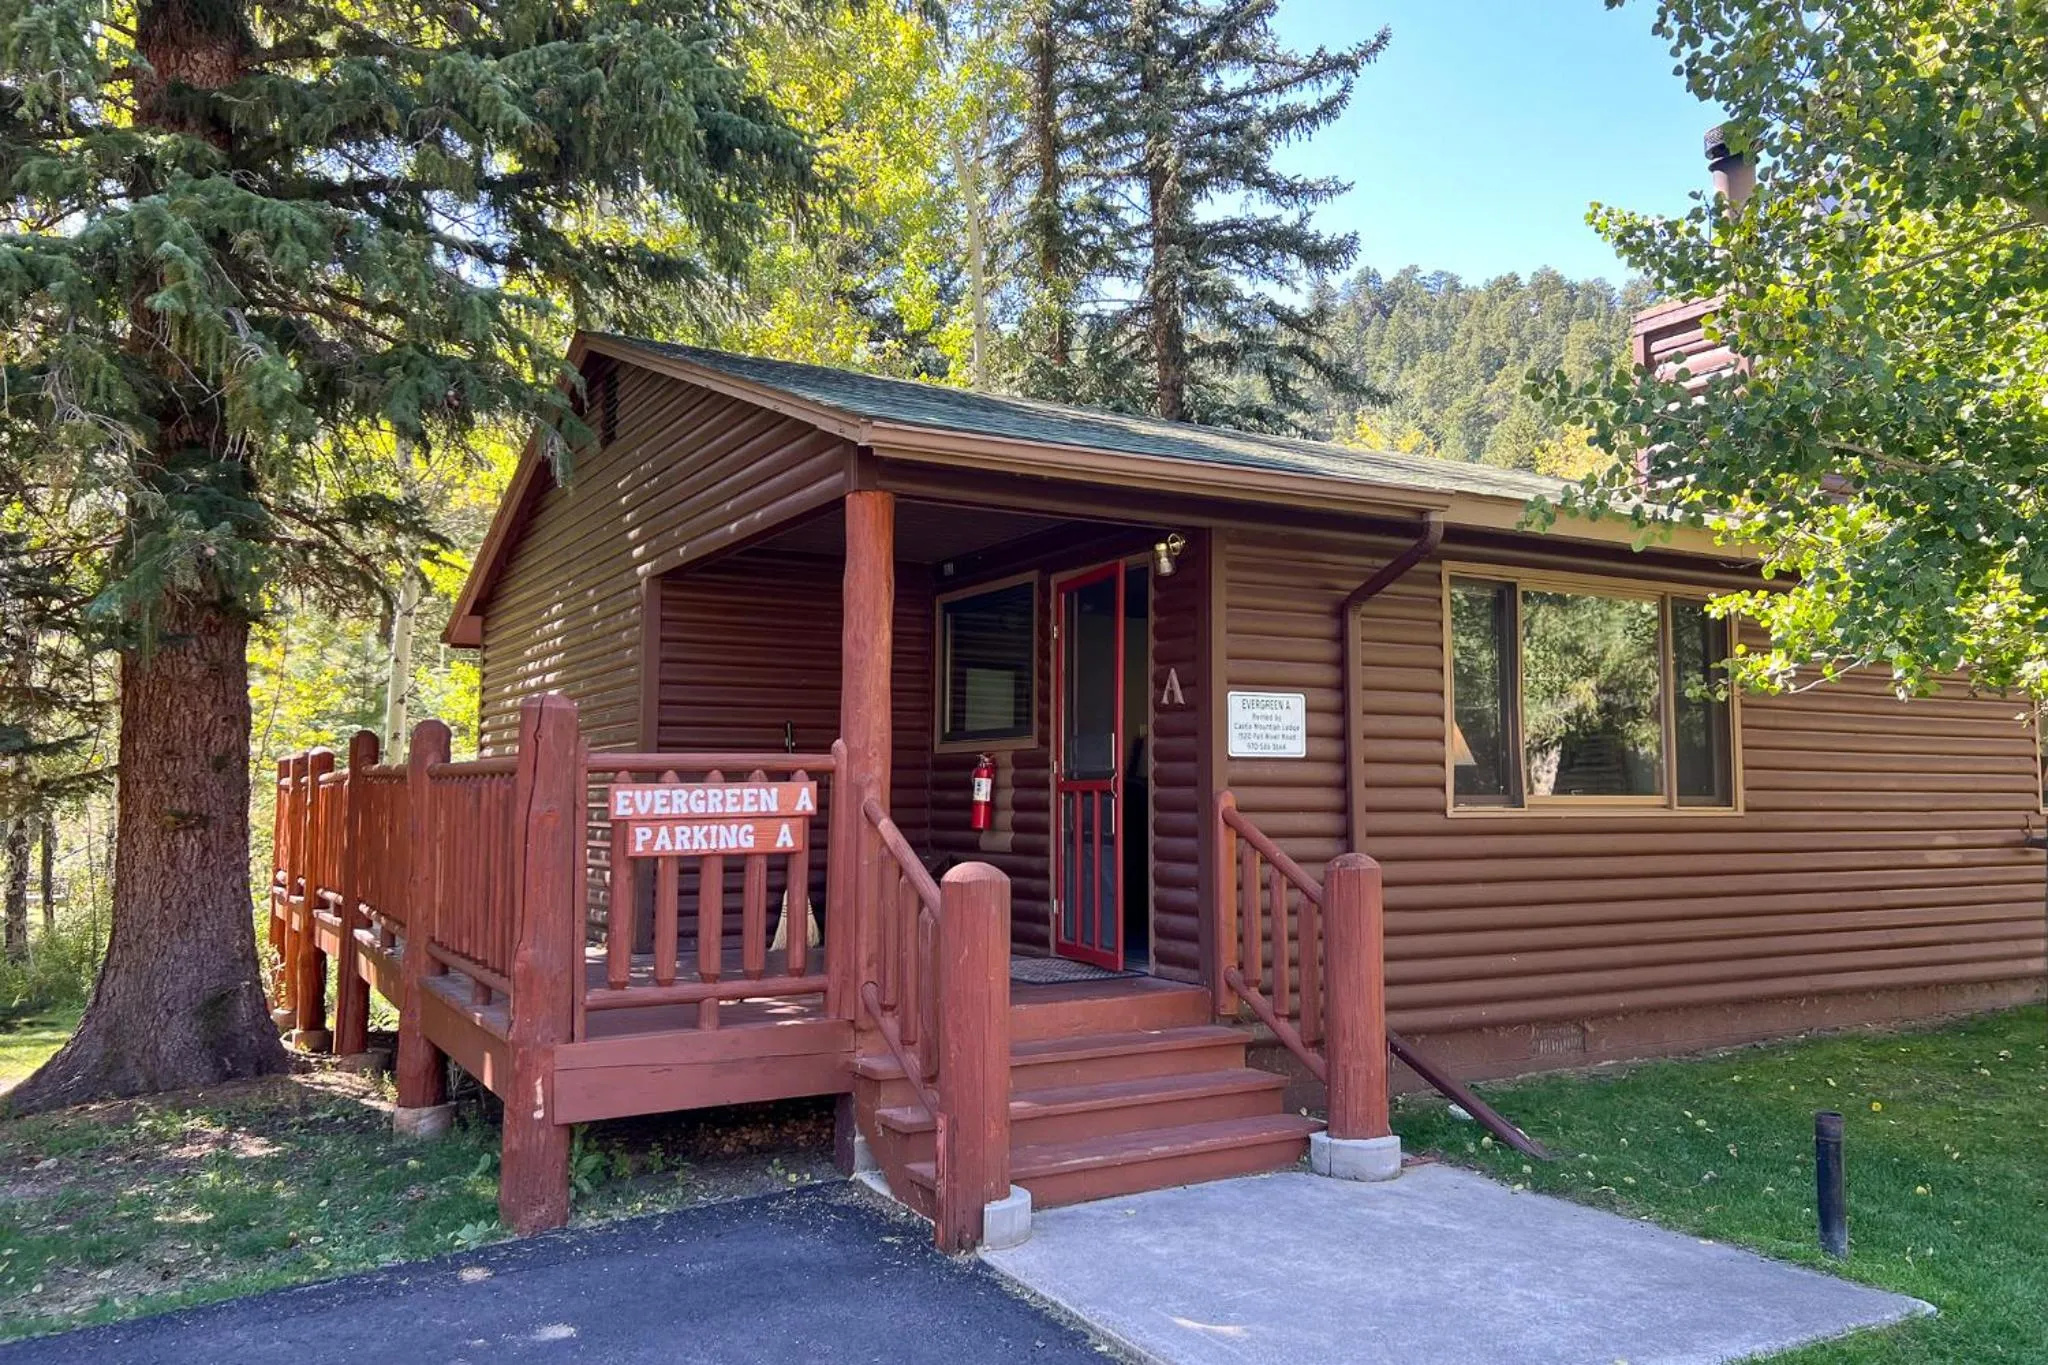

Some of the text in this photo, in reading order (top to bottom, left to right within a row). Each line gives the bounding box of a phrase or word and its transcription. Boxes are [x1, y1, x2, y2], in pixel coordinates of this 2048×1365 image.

[1160, 667, 1186, 705] A
[1241, 698, 1291, 710] EVERGREEN A
[615, 787, 814, 816] EVERGREEN A
[634, 823, 794, 852] PARKING A
